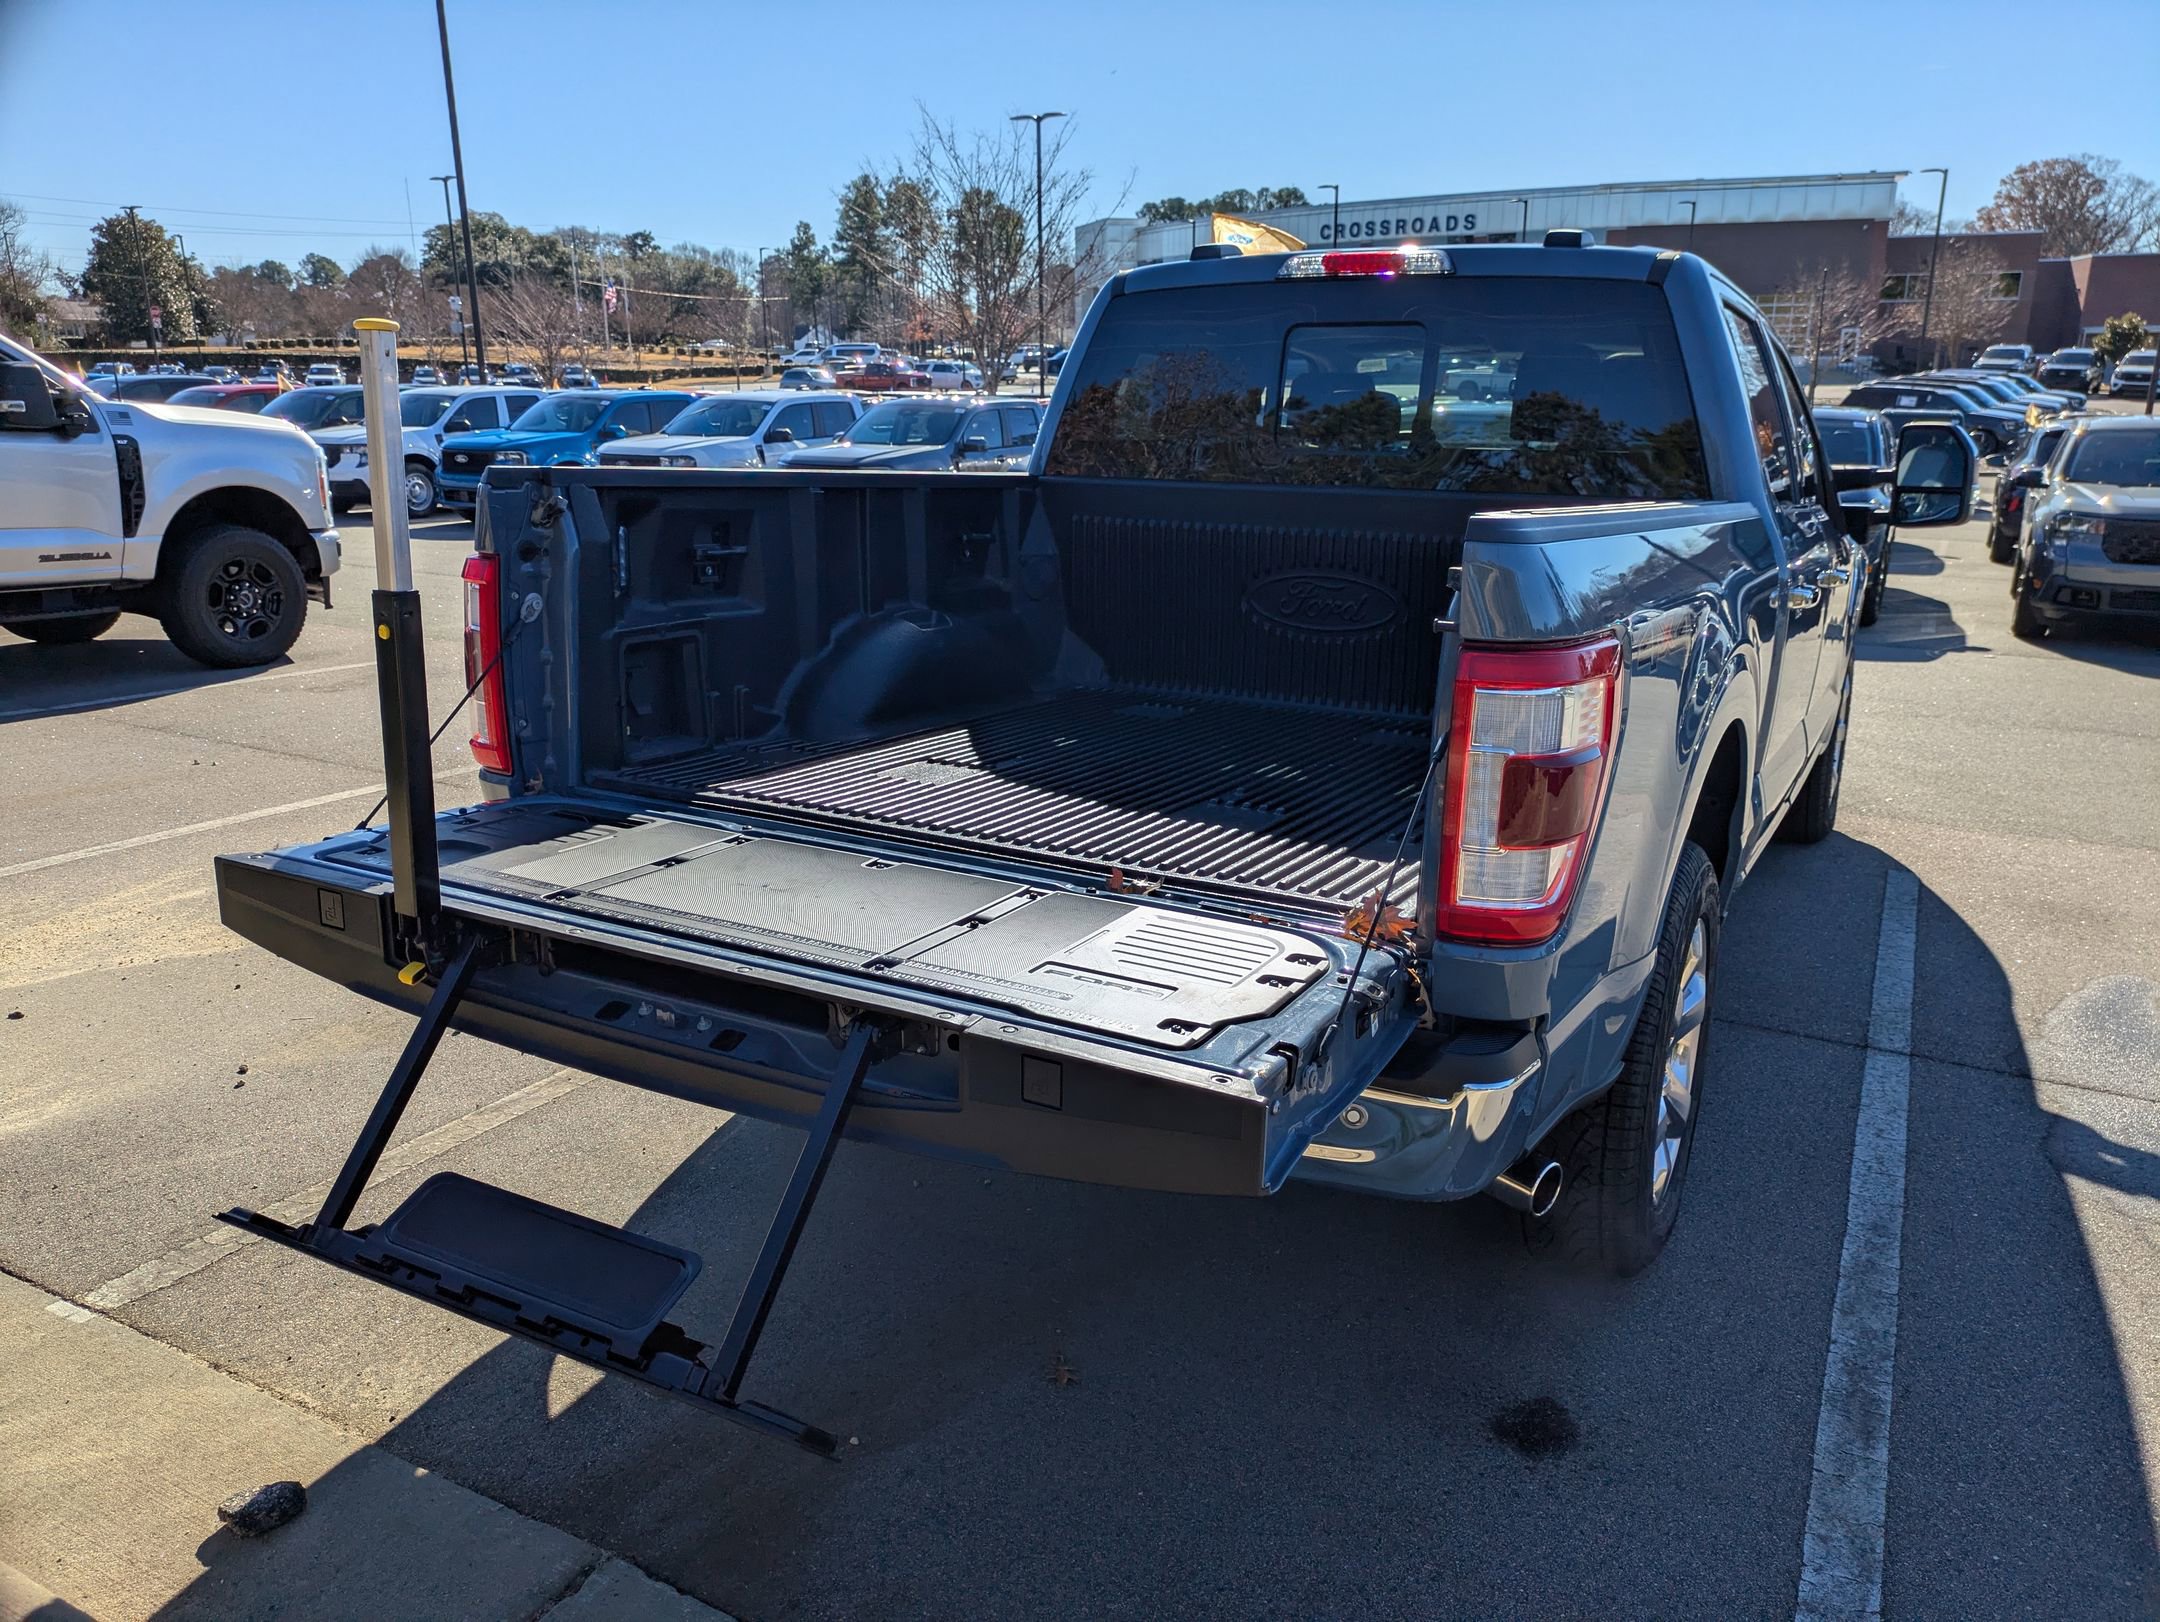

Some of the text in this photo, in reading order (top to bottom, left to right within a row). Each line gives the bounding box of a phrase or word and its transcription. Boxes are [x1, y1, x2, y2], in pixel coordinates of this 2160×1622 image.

[1320, 214, 1477, 240] CROSSROADS
[1279, 579, 1369, 622] Ford
[1043, 969, 1165, 998] FORD
